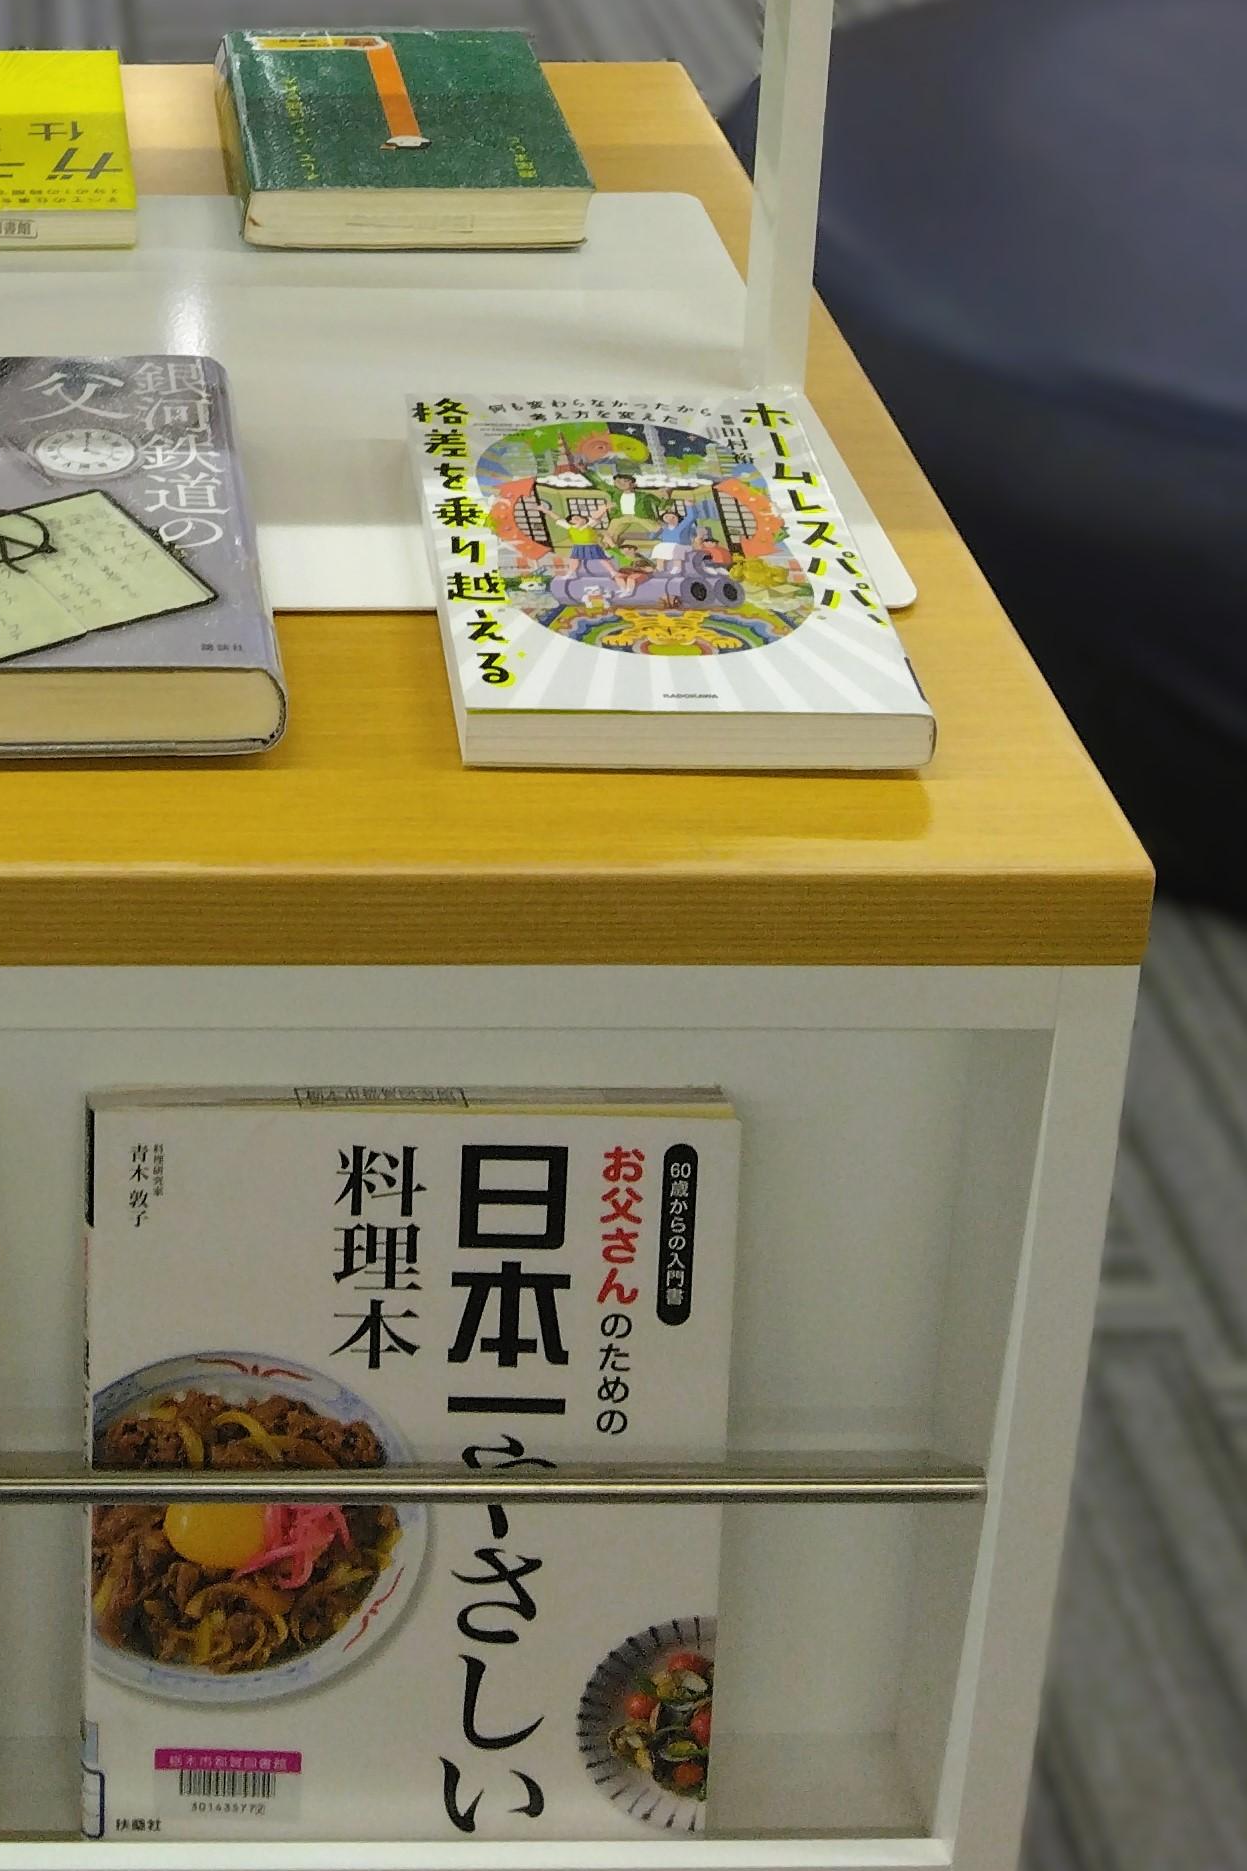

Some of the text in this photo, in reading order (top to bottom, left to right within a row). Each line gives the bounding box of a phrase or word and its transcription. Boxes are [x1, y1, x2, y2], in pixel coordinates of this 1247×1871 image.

[23, 373, 128, 422] 父
[131, 361, 231, 549] 銀河鉄道の
[488, 398, 712, 417] 何も変わらなかったから
[529, 410, 679, 424] 考え方を変えた
[412, 397, 514, 688] 格差を乗り越える
[129, 1143, 149, 1228] 青木敦子
[329, 1145, 427, 1370] 料理本
[664, 1162, 692, 1306] 60歳からの入門書
[594, 1147, 645, 1434] お父さんのための
[440, 1145, 572, 1833] 日本一やさしい
